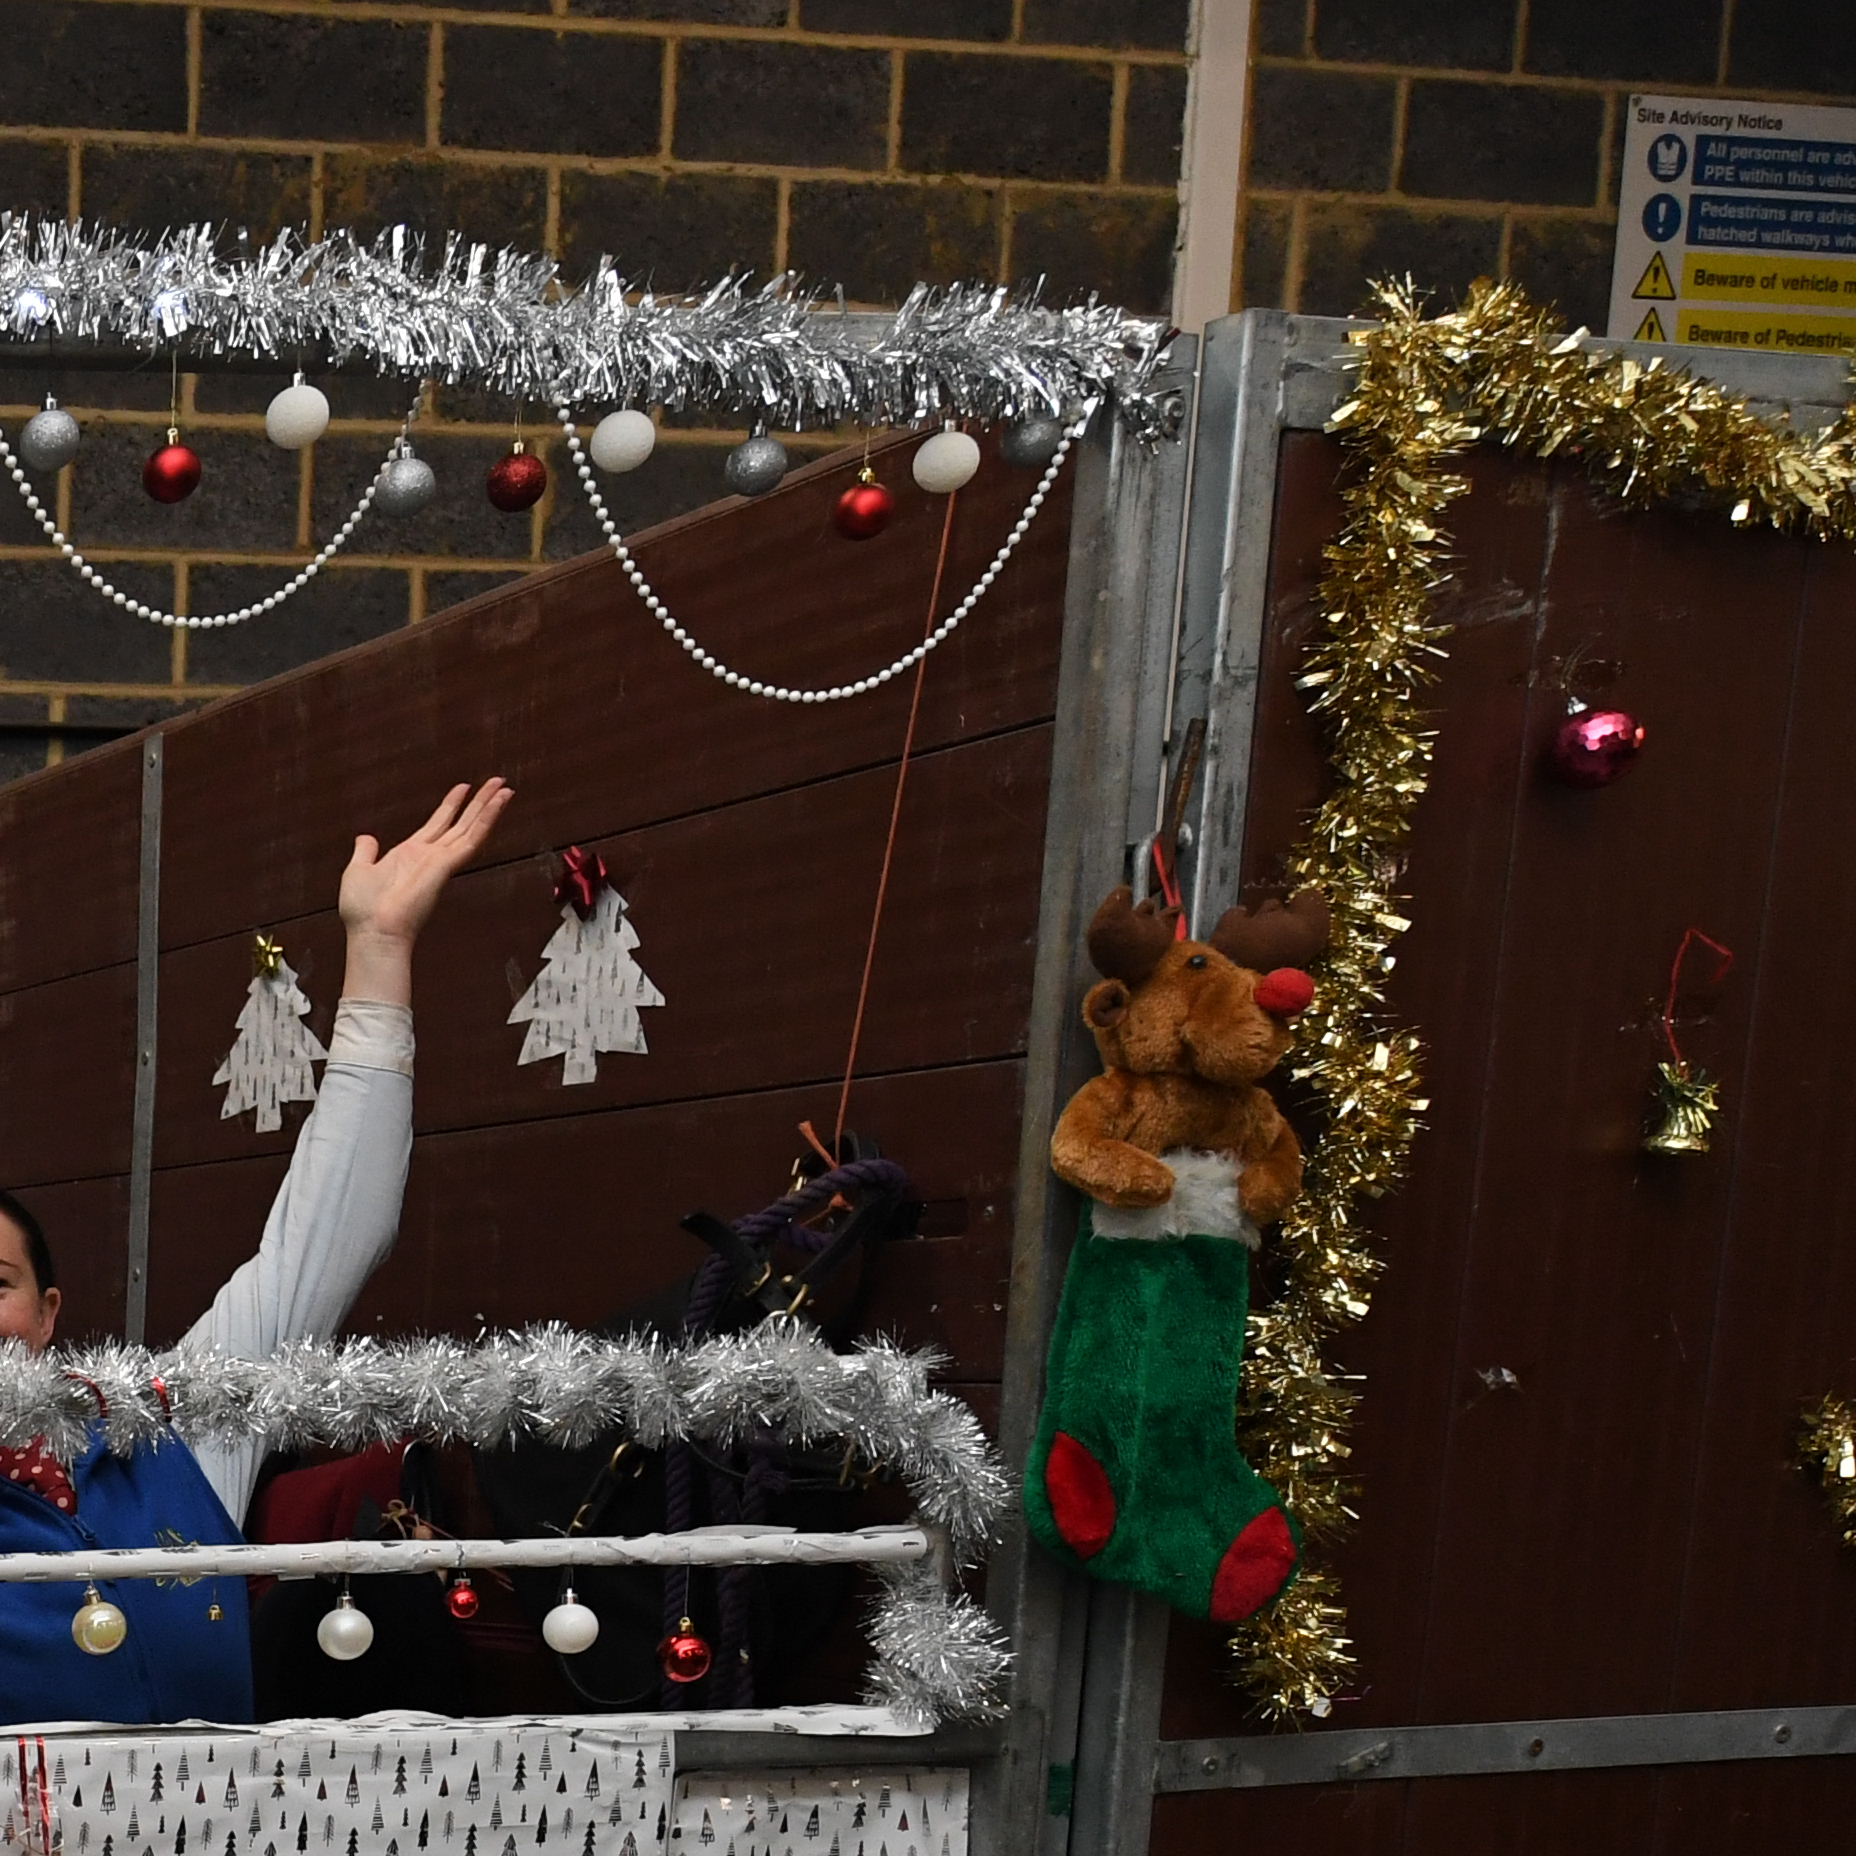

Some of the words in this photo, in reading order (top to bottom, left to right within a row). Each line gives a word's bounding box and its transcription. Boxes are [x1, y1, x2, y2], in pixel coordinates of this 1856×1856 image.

[1637, 107, 1664, 124] Site
[1669, 110, 1733, 131] Advisory
[1738, 114, 1783, 131] Notice
[1706, 141, 1727, 158] All
[1730, 146, 1803, 163] personnel
[1807, 150, 1830, 165] are
[1703, 165, 1736, 182] PPE
[1738, 167, 1784, 186] within
[1788, 171, 1814, 187] this
[1700, 201, 1786, 221] Pedestrians
[1790, 209, 1813, 223] are
[1697, 226, 1757, 243] hatched
[1761, 229, 1830, 250] walkways
[1693, 269, 1755, 288] Beware
[1760, 273, 1778, 289] of
[1782, 275, 1839, 293] vehicle
[1688, 325, 1749, 344] Beware
[1754, 329, 1771, 345] of
